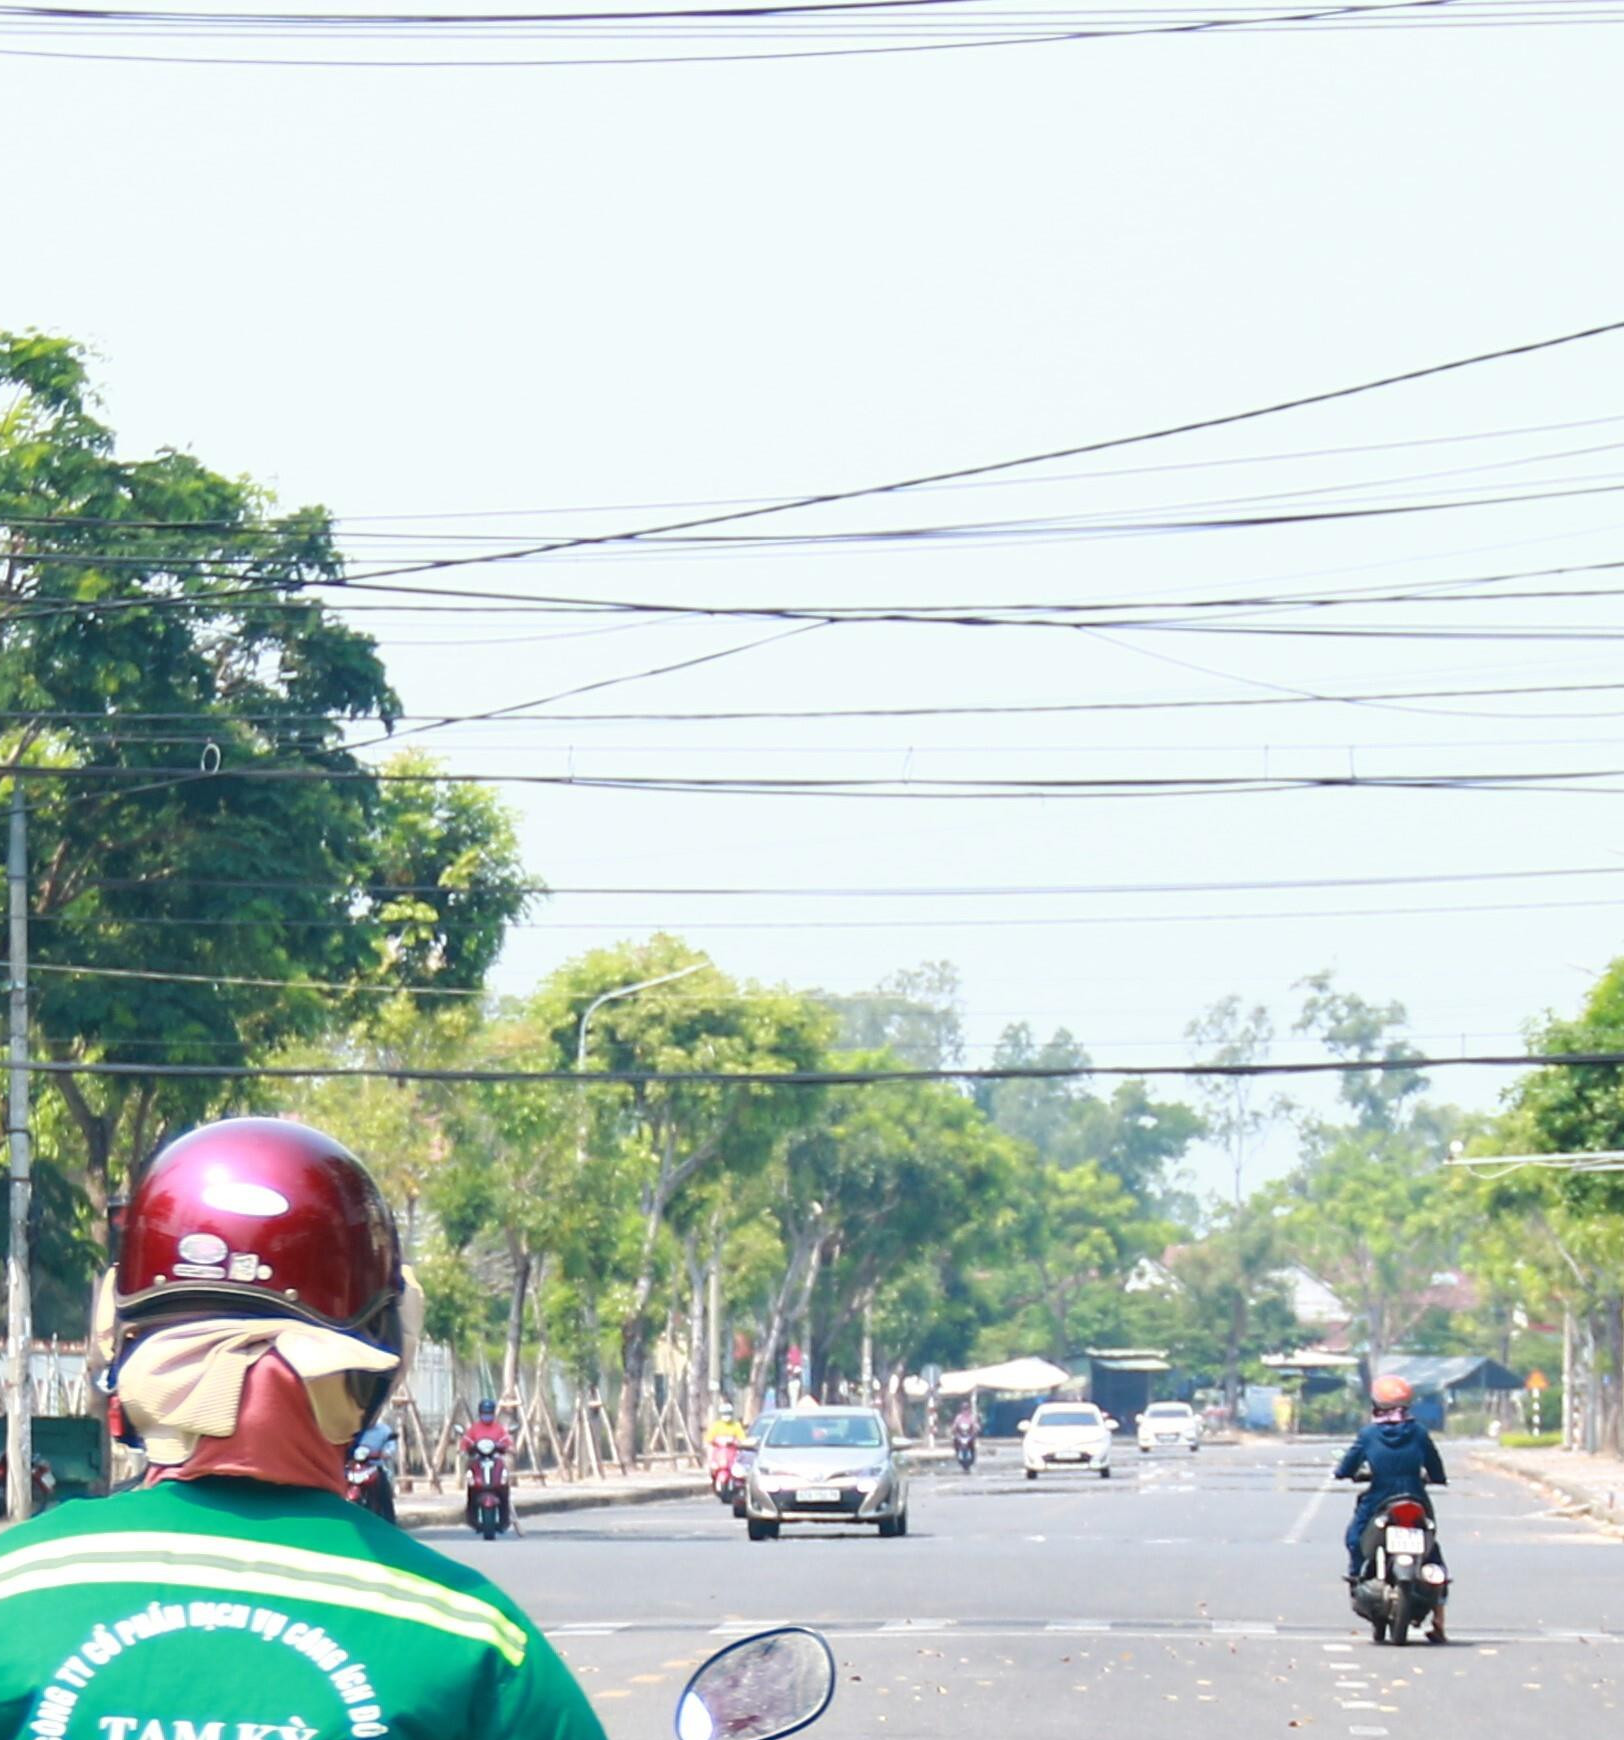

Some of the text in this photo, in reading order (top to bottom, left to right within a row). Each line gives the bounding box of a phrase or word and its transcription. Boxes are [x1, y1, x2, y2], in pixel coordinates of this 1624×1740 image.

[54, 1655, 95, 1688] TY
[251, 1608, 288, 1641] VỤ
[282, 1622, 346, 1672] CÔNG
